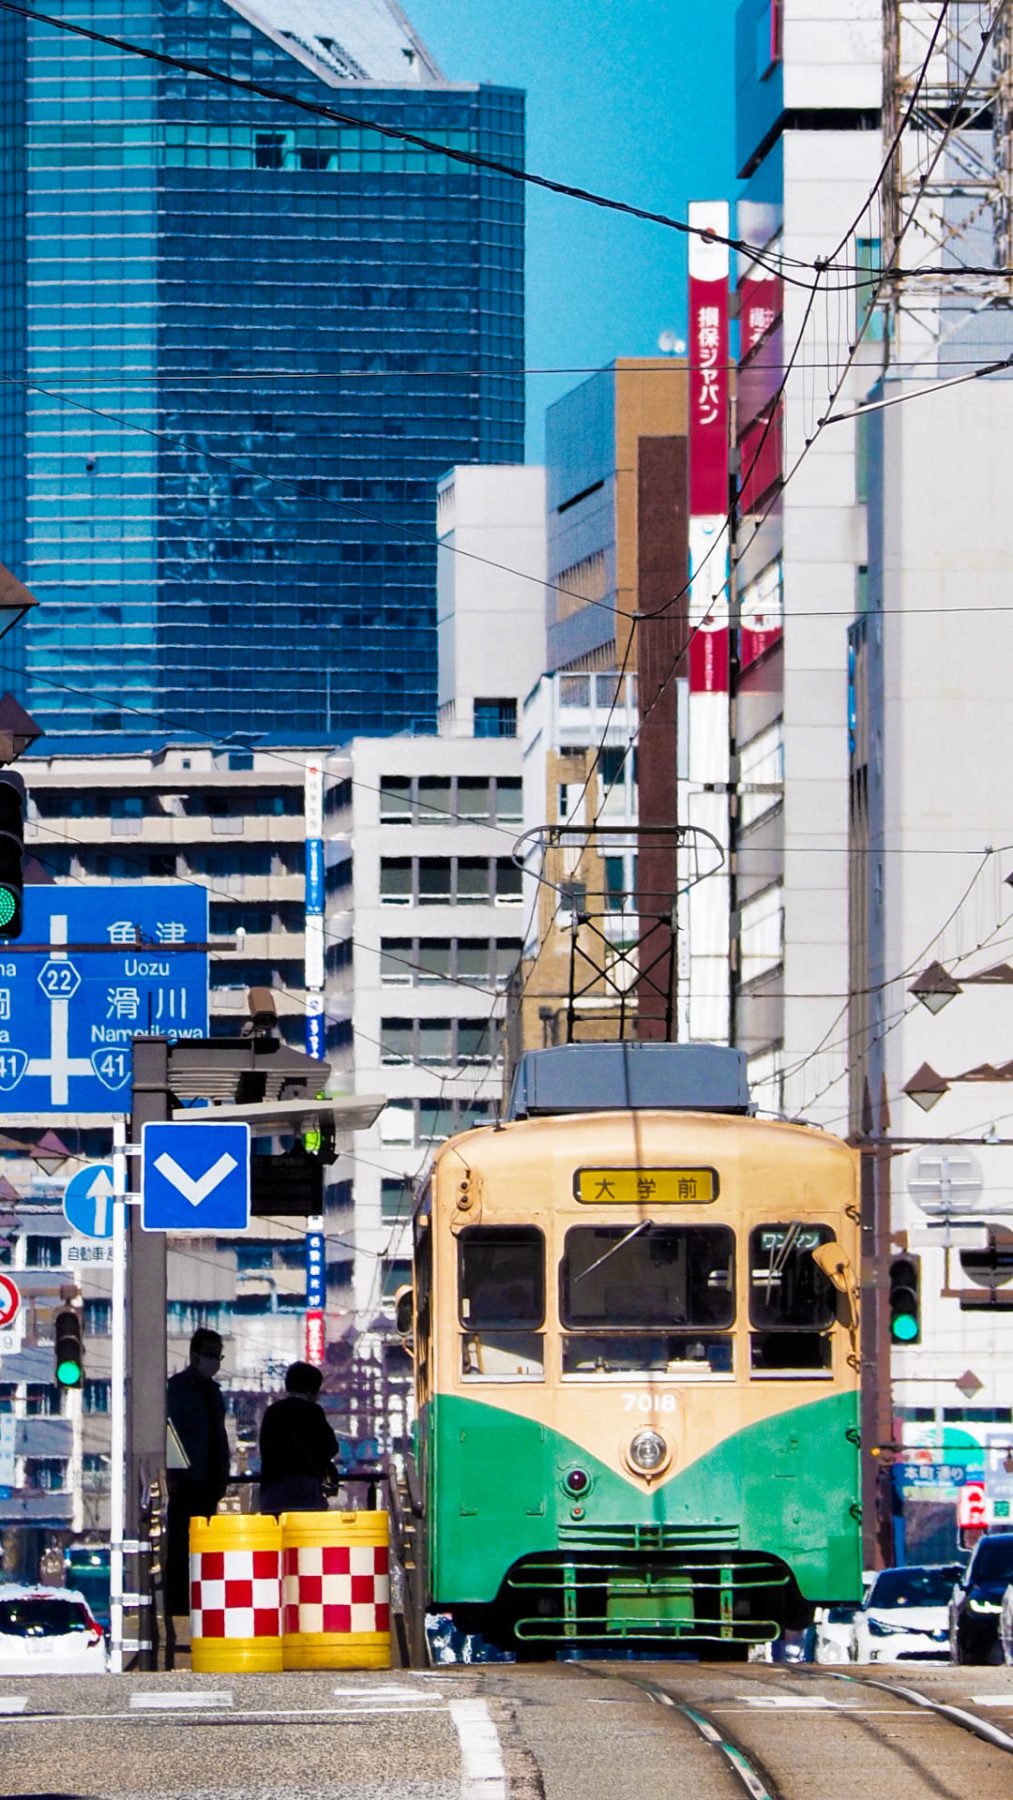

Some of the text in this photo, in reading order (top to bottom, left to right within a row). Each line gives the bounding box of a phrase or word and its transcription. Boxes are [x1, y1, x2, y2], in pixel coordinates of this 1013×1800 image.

[697, 307, 720, 425] 損保ジャパン
[107, 921, 188, 954] 魚津
[124, 959, 170, 977] Uozu
[47, 970, 72, 990] 22
[106, 987, 187, 1020] 滑川
[100, 1054, 125, 1078] 41
[594, 1178, 698, 1200] 大学前
[763, 1232, 819, 1249] ワンマン
[622, 1392, 676, 1412] 7018
[904, 1465, 964, 1481] 本町通り
